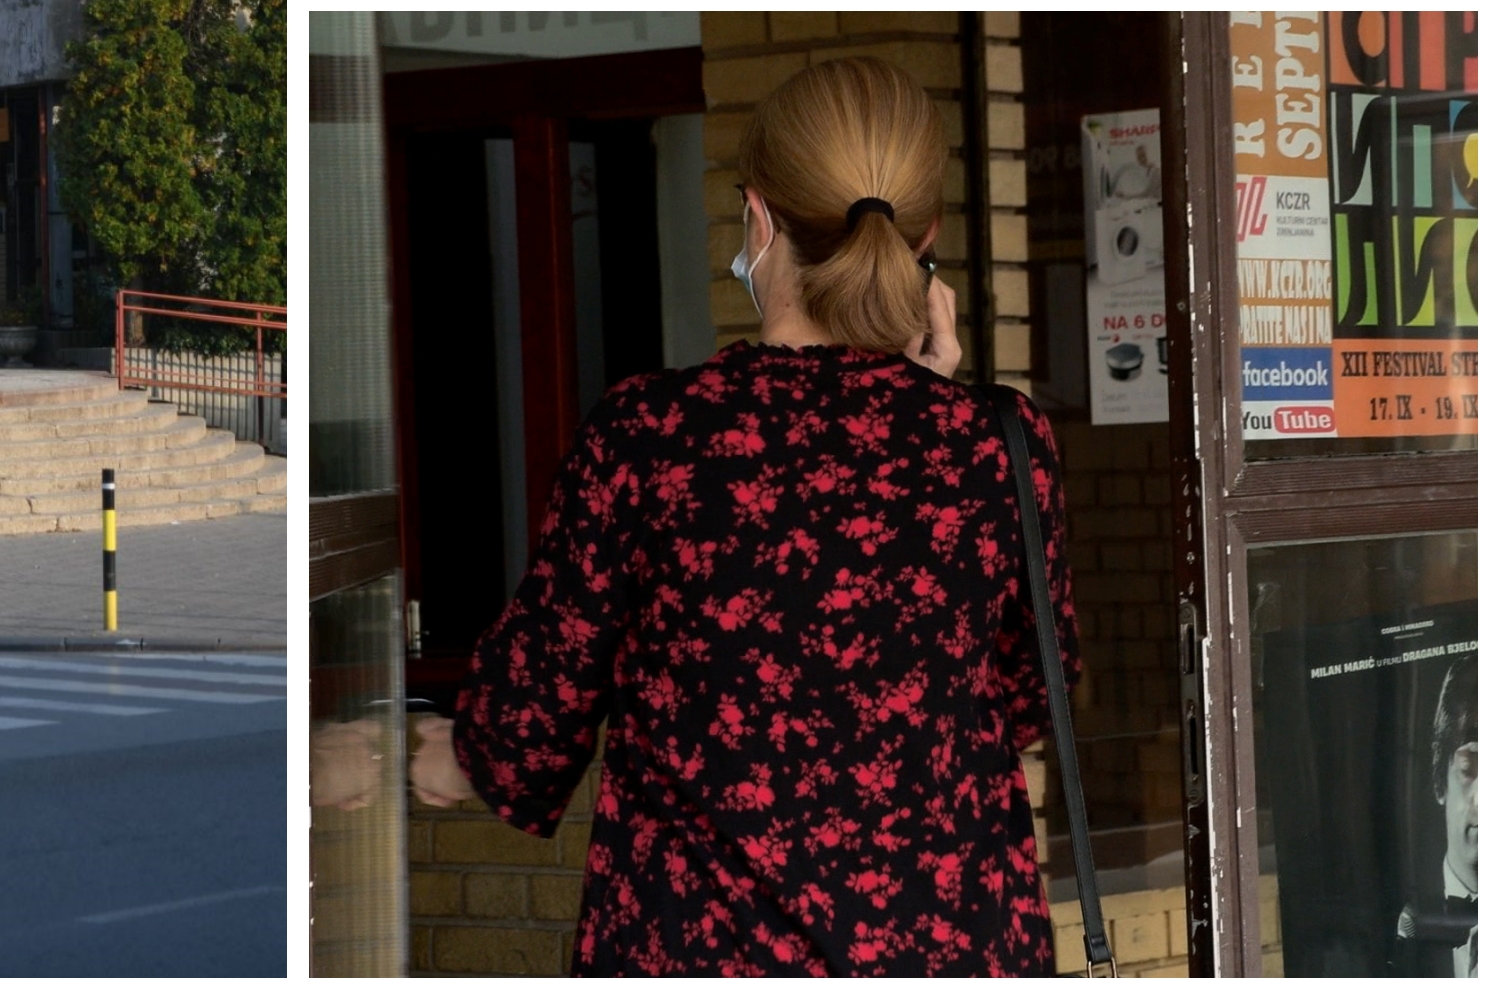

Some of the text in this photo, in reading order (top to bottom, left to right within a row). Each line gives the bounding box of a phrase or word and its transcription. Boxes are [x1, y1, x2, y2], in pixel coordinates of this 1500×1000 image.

[1275, 11, 1323, 160] SEPT
[1276, 191, 1311, 210] KCZR
[1103, 313, 1166, 330] NA 6 D
[1242, 361, 1328, 386] facebook
[1341, 351, 1369, 377] XII
[1373, 351, 1446, 377] FESTIVAL
[1370, 397, 1392, 420] 17.
[1396, 394, 1413, 420] IX
[1435, 396, 1458, 420] 19.
[1311, 663, 1342, 679] MILAN
[1344, 656, 1375, 673] MARIĆ
[1402, 645, 1445, 662] DRAGANA
[1447, 640, 1478, 654] BJELO
